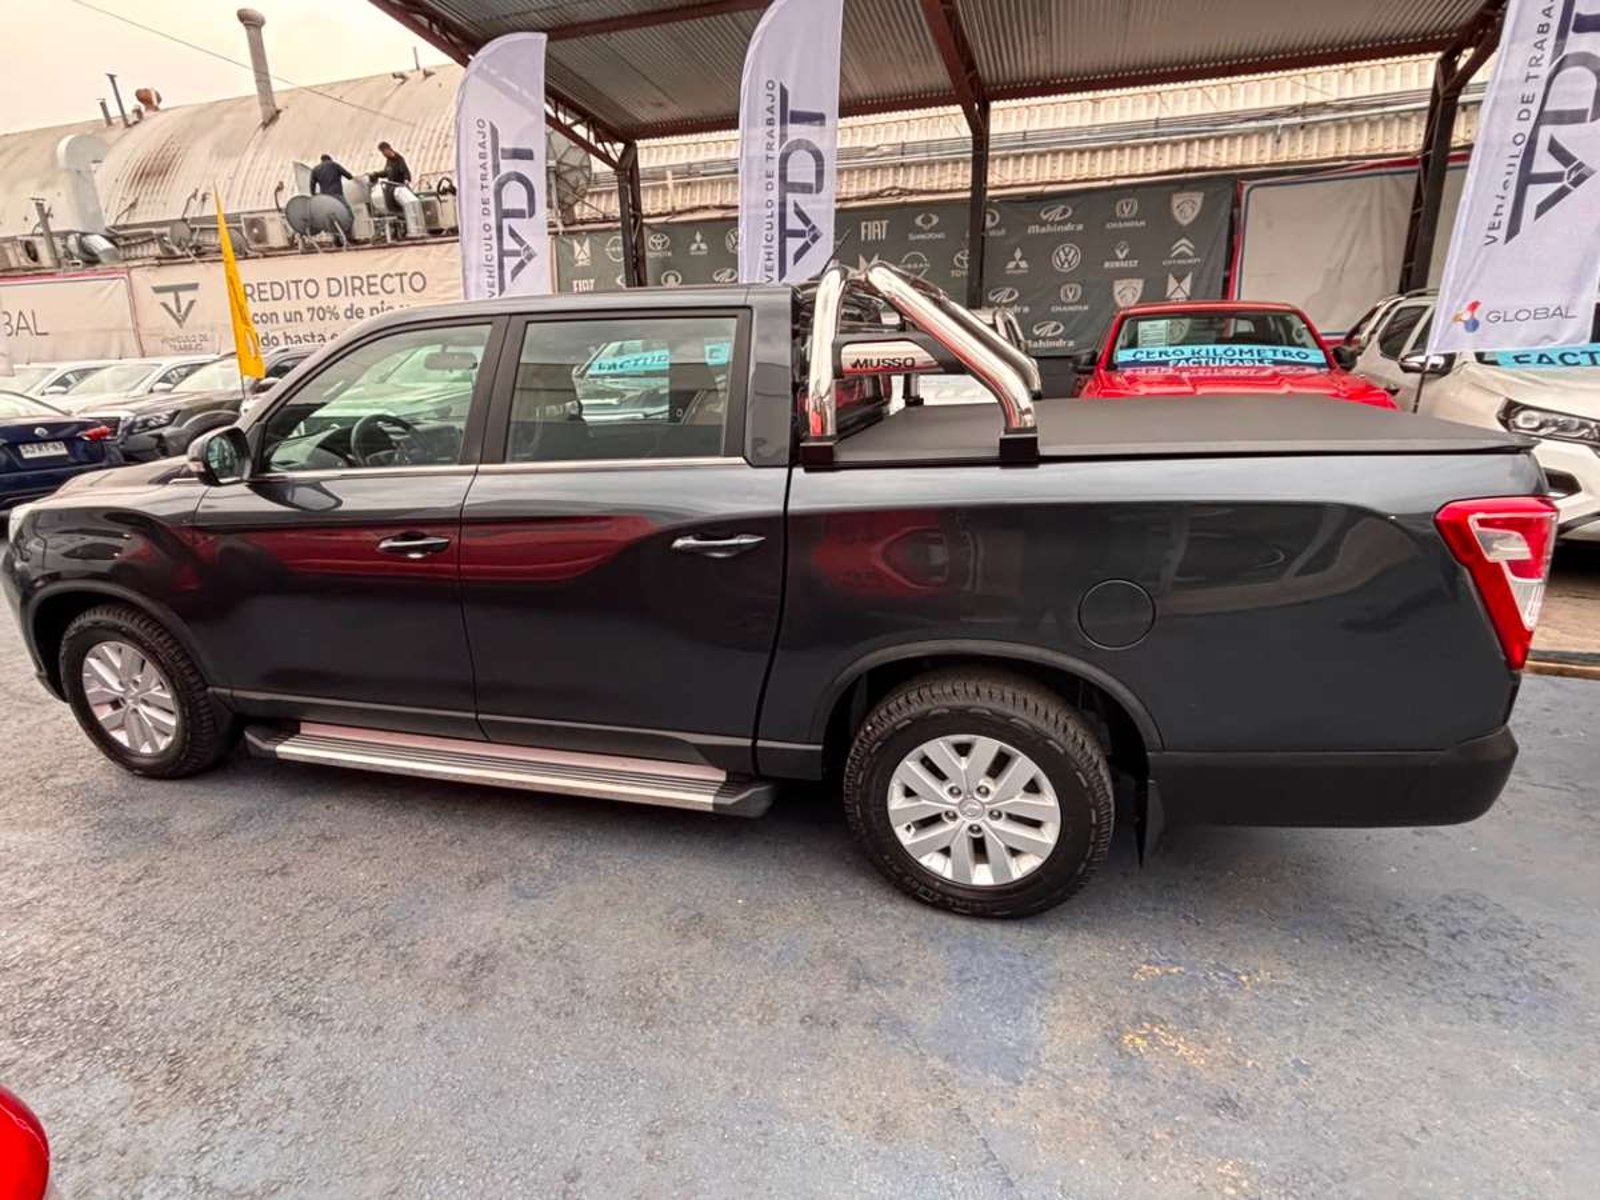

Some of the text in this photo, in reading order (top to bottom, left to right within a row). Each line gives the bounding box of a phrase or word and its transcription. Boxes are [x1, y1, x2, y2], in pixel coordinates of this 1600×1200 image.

[1524, 0, 1557, 83] TRABA
[1516, 92, 1535, 124] DE
[765, 80, 776, 162] TRABAJO
[476, 118, 490, 191] TRABAJO
[765, 169, 775, 191] DE
[481, 197, 491, 216] DE
[860, 219, 889, 242] FIAT
[1027, 222, 1084, 234] Mahindra
[243, 271, 427, 302] REDITO DIRECTO
[252, 311, 279, 325] con
[283, 311, 304, 324] un
[306, 304, 340, 322] 70%
[344, 303, 365, 320] de
[1485, 307, 1578, 323] GLOBAL
[850, 356, 916, 369] MUSSO
[1132, 346, 1310, 361] CERO KILÓMETRO
